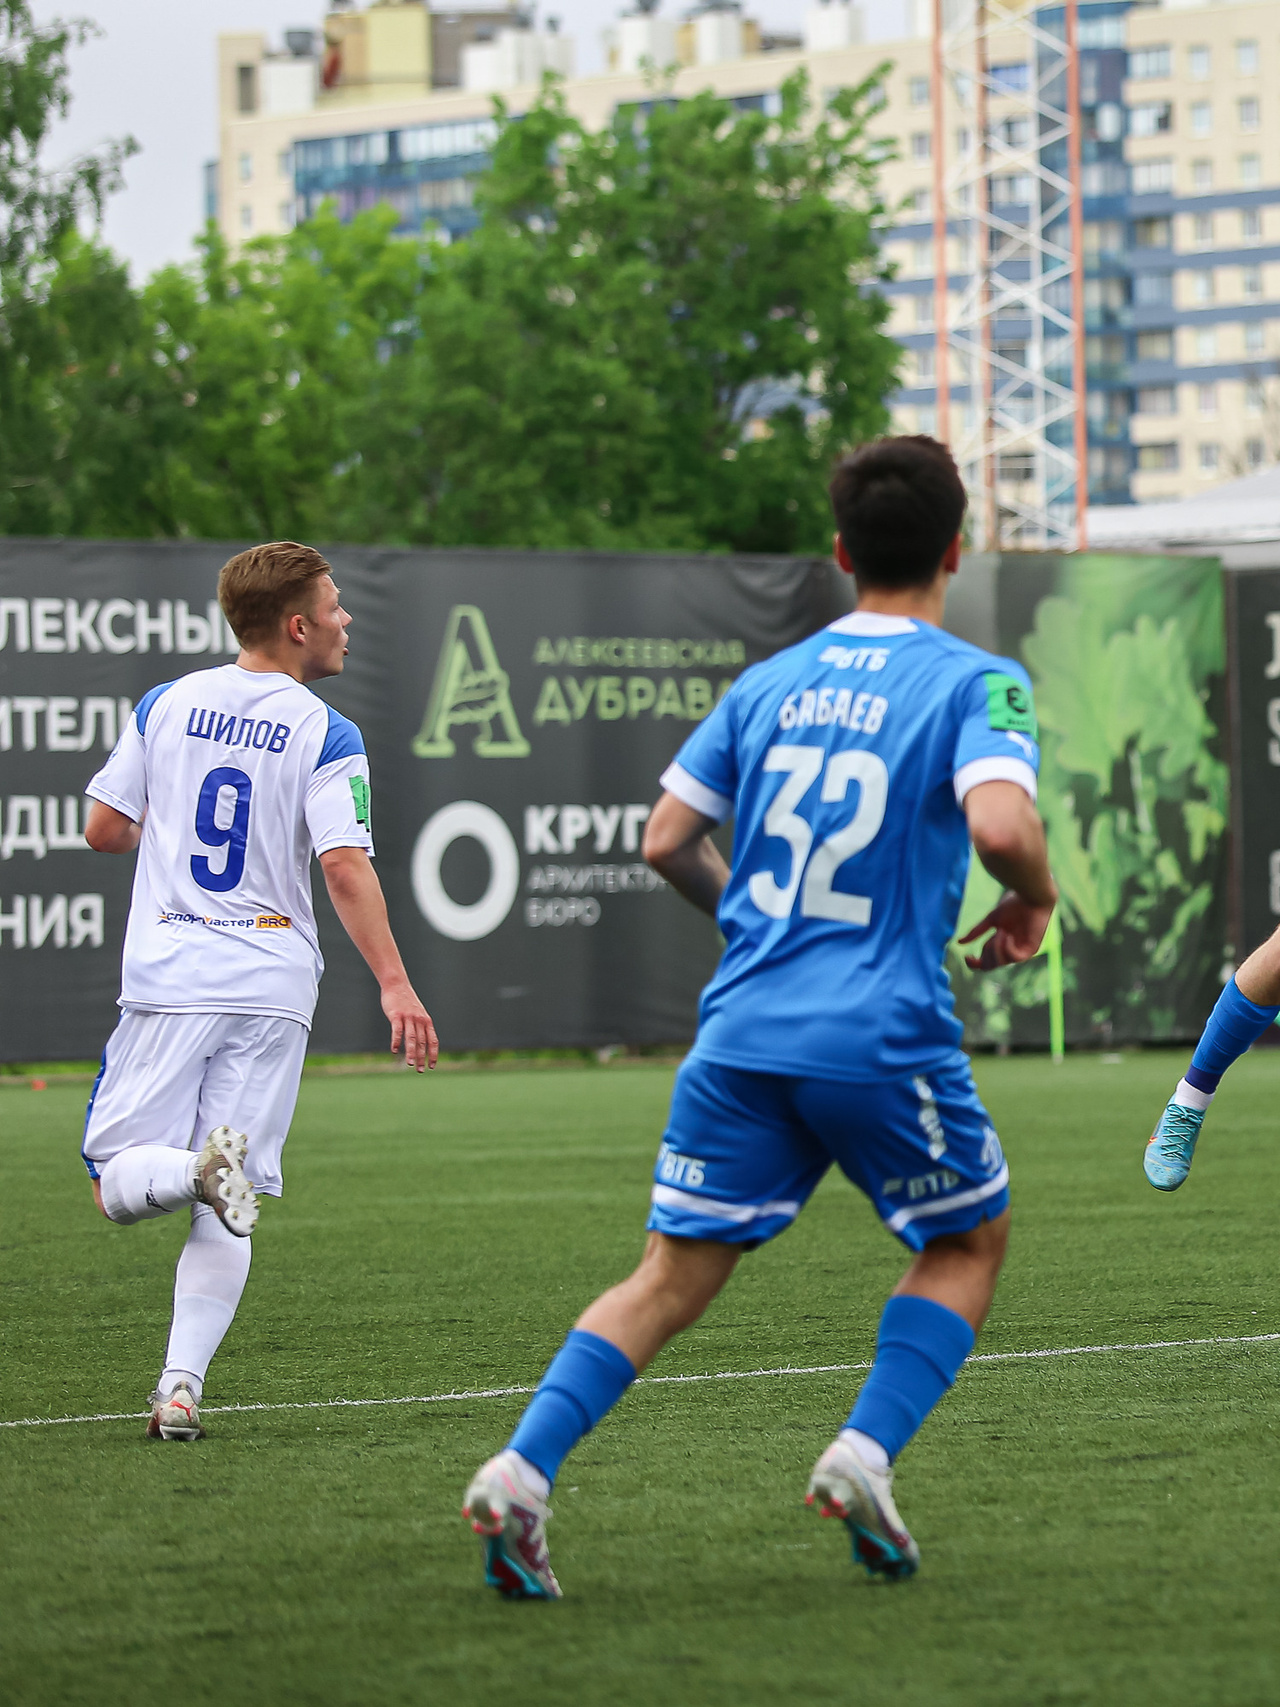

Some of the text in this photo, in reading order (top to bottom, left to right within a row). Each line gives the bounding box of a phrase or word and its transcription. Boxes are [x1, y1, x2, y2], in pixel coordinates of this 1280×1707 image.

[186, 707, 291, 754] ШИЛОВ
[779, 687, 889, 735] БАБАЕВ
[190, 766, 252, 892] 9
[749, 745, 888, 926] 32
[258, 916, 290, 928] PRO
